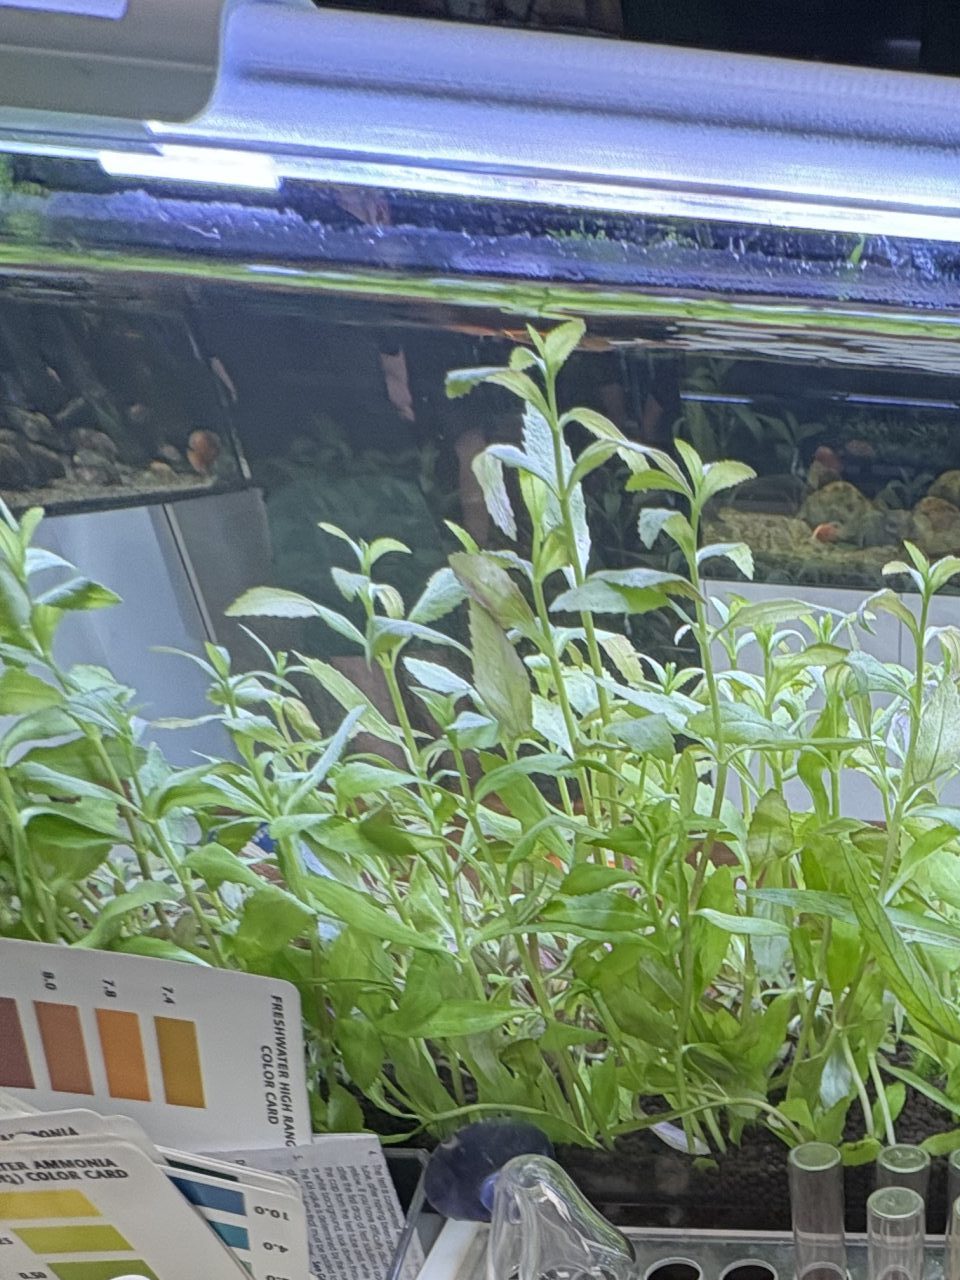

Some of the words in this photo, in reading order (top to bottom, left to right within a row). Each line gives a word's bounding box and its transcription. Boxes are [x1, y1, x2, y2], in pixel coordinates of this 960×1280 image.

[101, 978, 117, 998] 7.8
[270, 994, 289, 1079] FRESHWATER
[260, 1045, 275, 1089] COLOR
[265, 1092, 279, 1125] CARD
[279, 1081, 293, 1112] HIGH
[283, 1115, 296, 1148] RANG
[25, 1171, 82, 1181] COLOR
[84, 1169, 129, 1179] CARD
[33, 1158, 118, 1170] AMMONIA
